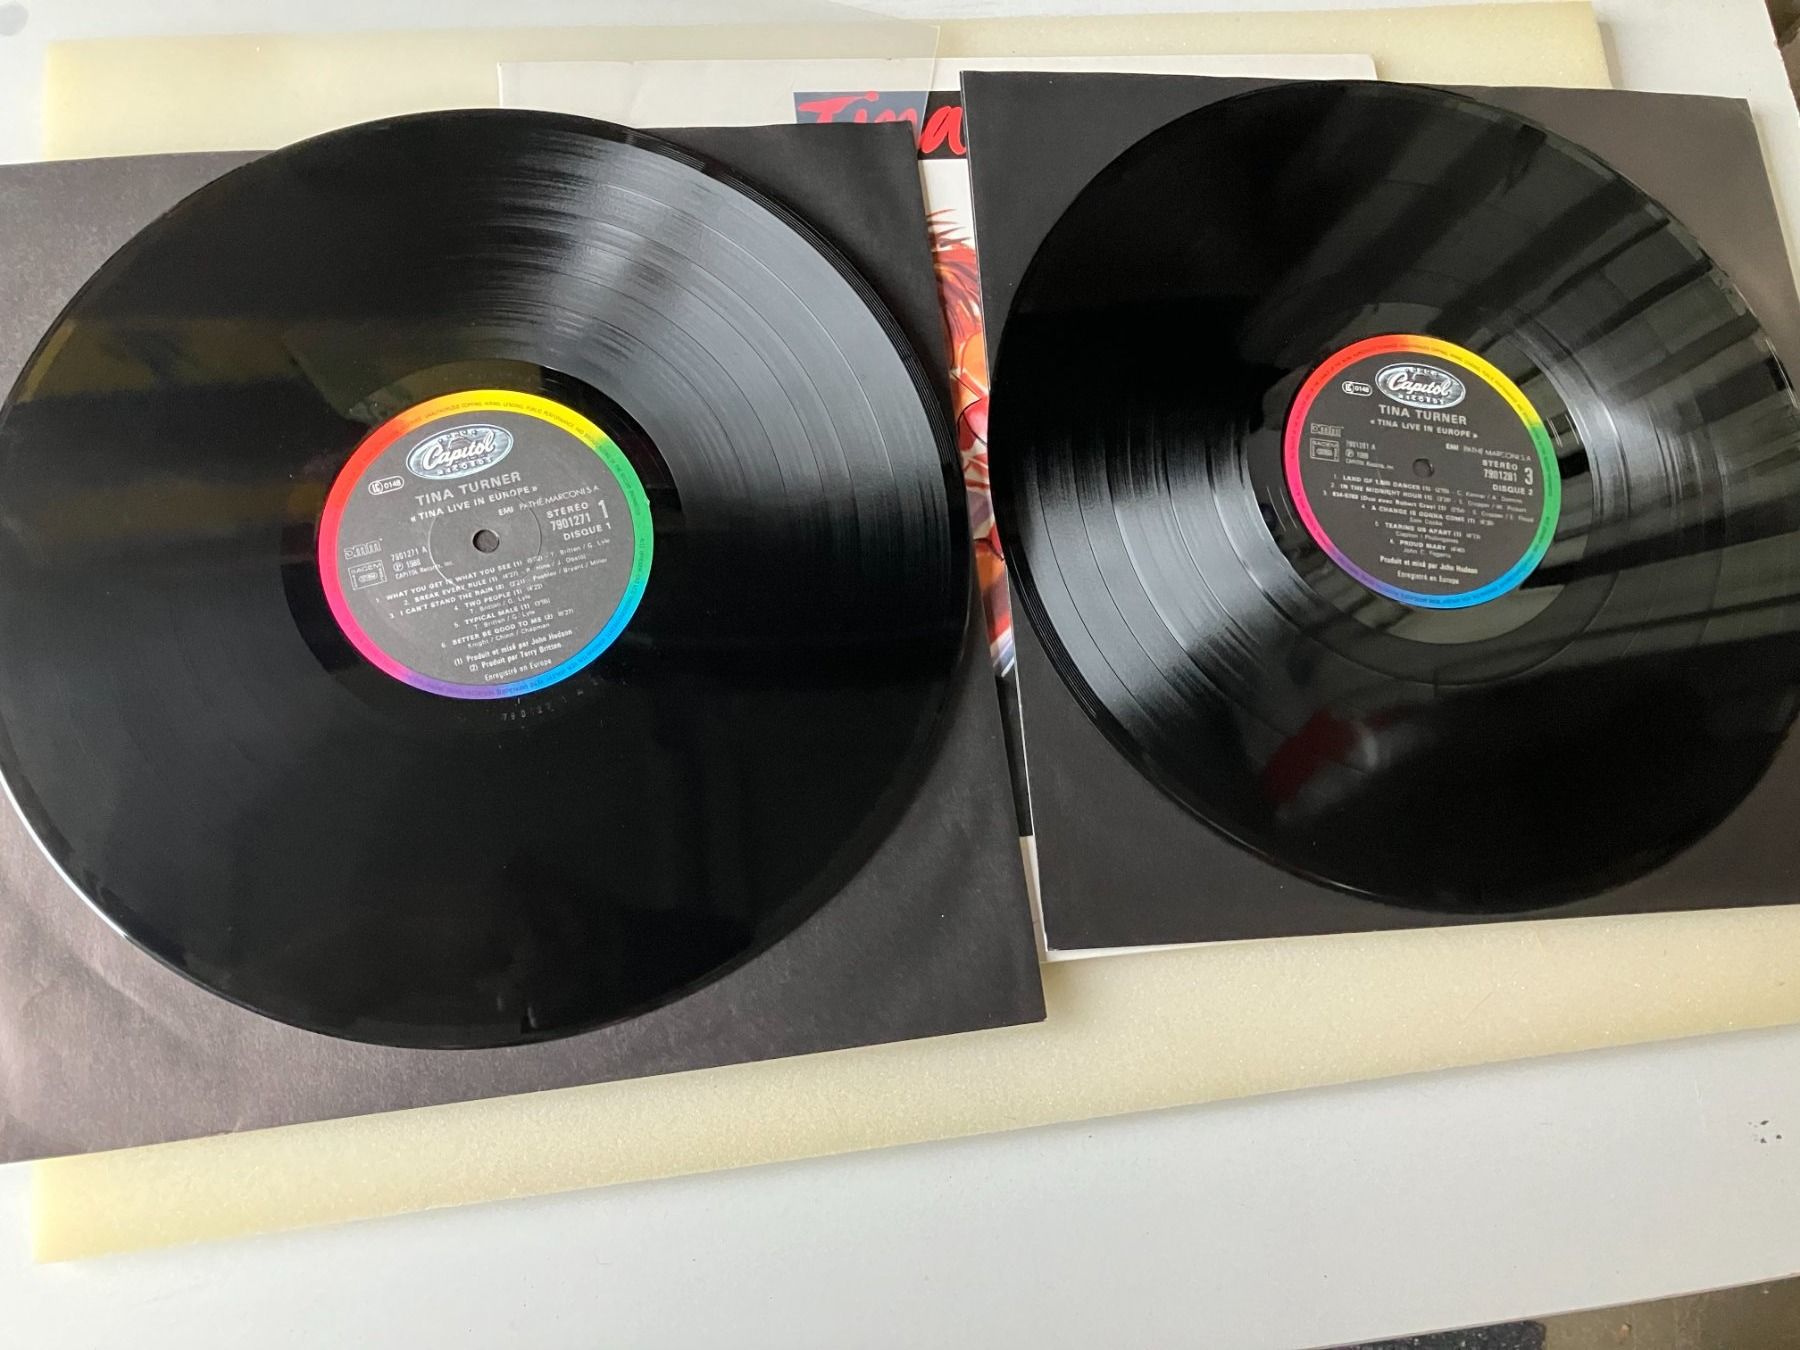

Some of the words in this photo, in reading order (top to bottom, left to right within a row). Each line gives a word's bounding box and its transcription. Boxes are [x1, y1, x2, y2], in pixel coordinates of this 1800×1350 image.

[1388, 372, 1452, 396] Capitol
[1378, 404, 1410, 418] TINA
[1415, 409, 1467, 426] TURNER
[1377, 418, 1398, 428] TINA
[1401, 422, 1420, 432] LIVE
[1423, 425, 1433, 433] IN
[1437, 426, 1471, 438] EUROPE
[423, 428, 495, 470] Capitol
[1524, 467, 1534, 485] 3
[415, 488, 454, 506] TINA
[458, 471, 521, 495] TURNER
[1350, 484, 1363, 492] THE
[1365, 486, 1401, 497] MIDNIGHT
[1392, 481, 1420, 491] DANCES
[1492, 484, 1526, 496] DISQUE
[418, 508, 444, 520] TINA
[447, 500, 471, 513] LIVE
[474, 496, 486, 507] IN
[488, 486, 530, 503] EUROPE
[497, 506, 514, 516] EMI
[598, 499, 609, 519] 1
[1378, 506, 1408, 515] CHANGE
[550, 512, 591, 531] 7901271
[1384, 521, 1415, 532] TEARING
[1428, 527, 1452, 536] APART
[563, 524, 603, 541] DISQUE
[605, 522, 611, 530] 1
[1399, 539, 1424, 548] PROUD
[1425, 543, 1447, 551] MARY
[386, 589, 409, 600] WHAT
[411, 585, 427, 594] YOU
[428, 581, 443, 590] GET
[455, 571, 477, 582] WHAT
[479, 567, 495, 576] YOU
[414, 591, 440, 603] BREAK
[442, 585, 465, 596] EVERY
[468, 579, 487, 589] RULE
[430, 597, 456, 608] STAND
[458, 592, 472, 601] THE
[475, 586, 493, 597] RAIN
[464, 599, 481, 608] TWO
[483, 591, 511, 603] PEOPLE
[464, 612, 496, 625] TYPICAL
[498, 606, 519, 616] MALE
[452, 633, 480, 645] BETTER
[482, 629, 492, 638] BE
[494, 623, 516, 634] GOOD
[530, 616, 542, 624] ME
[454, 658, 464, 667] (1)
[466, 649, 491, 662] Produit
[492, 648, 499, 656] et
[518, 641, 529, 650] par
[531, 635, 547, 646] John
[548, 629, 573, 641] Hudson
[481, 656, 506, 669] Produit
[507, 654, 518, 664] par
[519, 648, 538, 659] Terry
[538, 642, 562, 654] Britten
[529, 658, 552, 670] Europe
